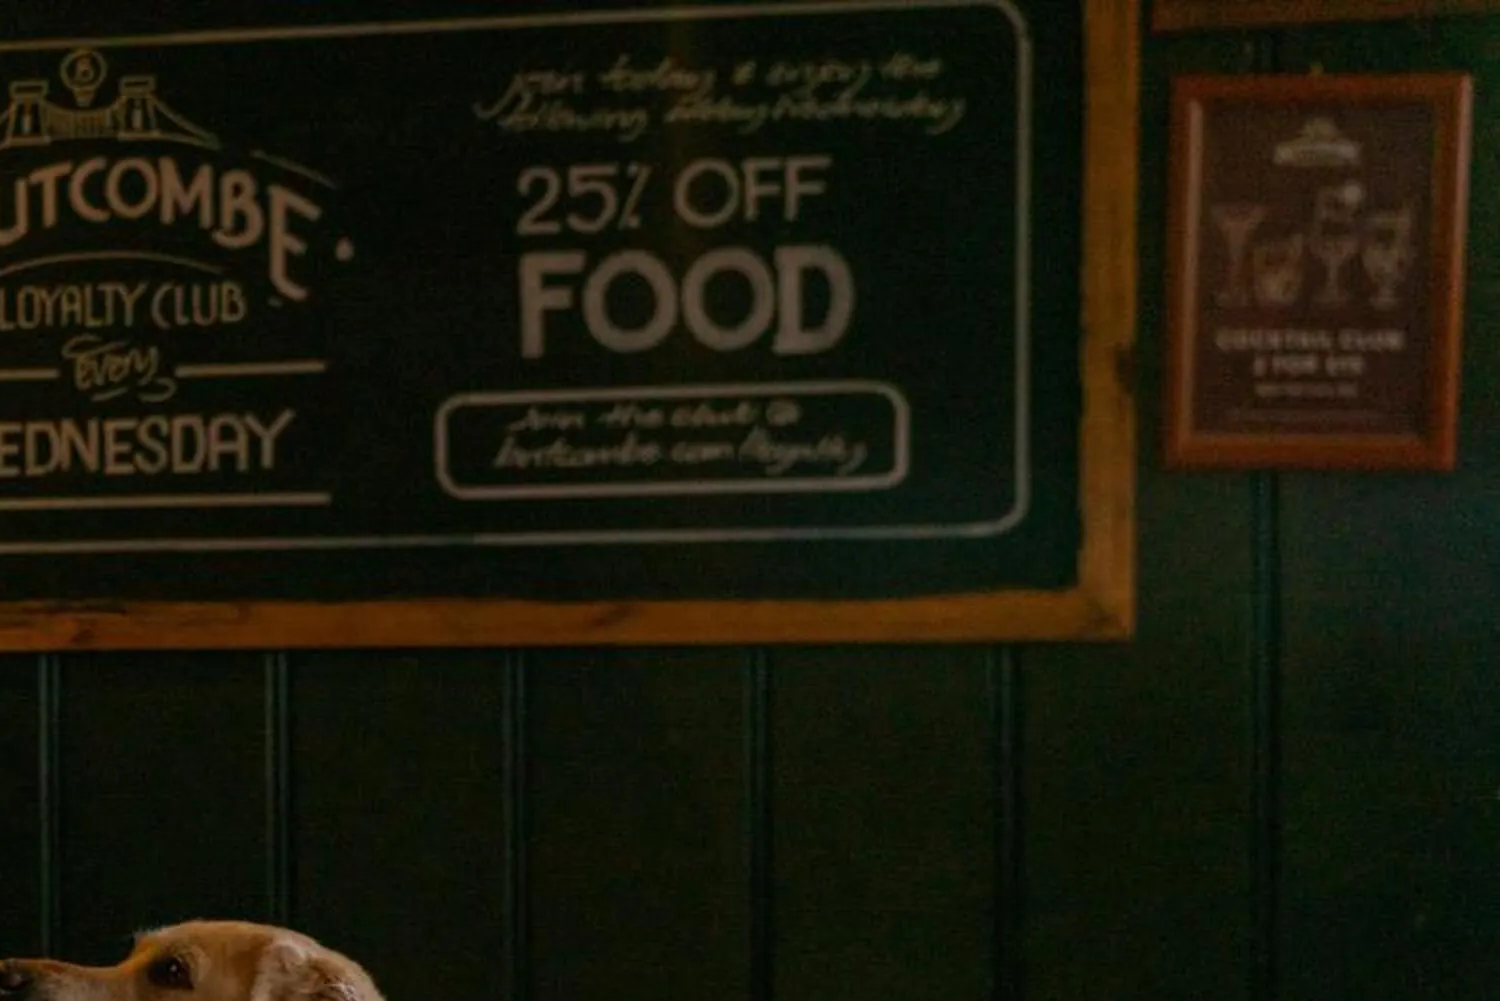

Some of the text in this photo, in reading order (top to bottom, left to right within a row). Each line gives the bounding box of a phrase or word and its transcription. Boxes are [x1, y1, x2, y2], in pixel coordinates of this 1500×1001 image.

[516, 157, 832, 235] 25% OFF
[151, 281, 247, 326] CLUB
[518, 244, 855, 359] FOOD
